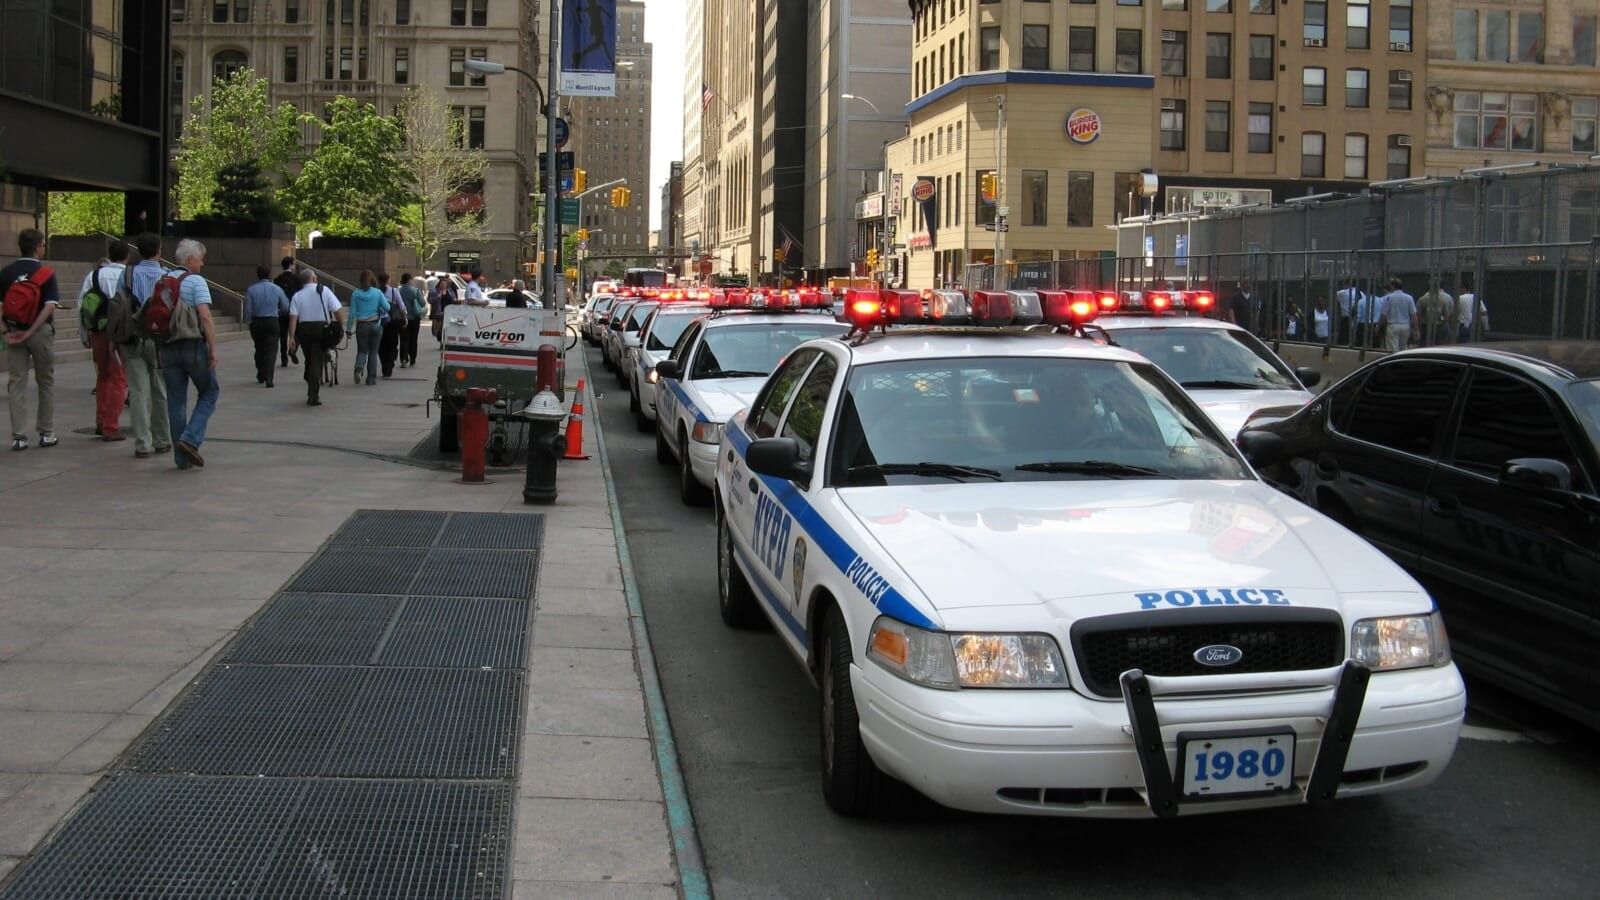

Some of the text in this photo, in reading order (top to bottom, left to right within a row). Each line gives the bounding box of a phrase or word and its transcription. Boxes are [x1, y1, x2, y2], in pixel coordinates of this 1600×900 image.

[1070, 114, 1097, 127] BURGER
[1071, 121, 1098, 137] KING
[475, 329, 525, 344] verizon
[752, 490, 792, 581] NYPD
[846, 555, 890, 606] POLICE
[1134, 588, 1290, 610] POLICE
[1206, 649, 1231, 662] Ford
[1194, 748, 1285, 782] 1980
